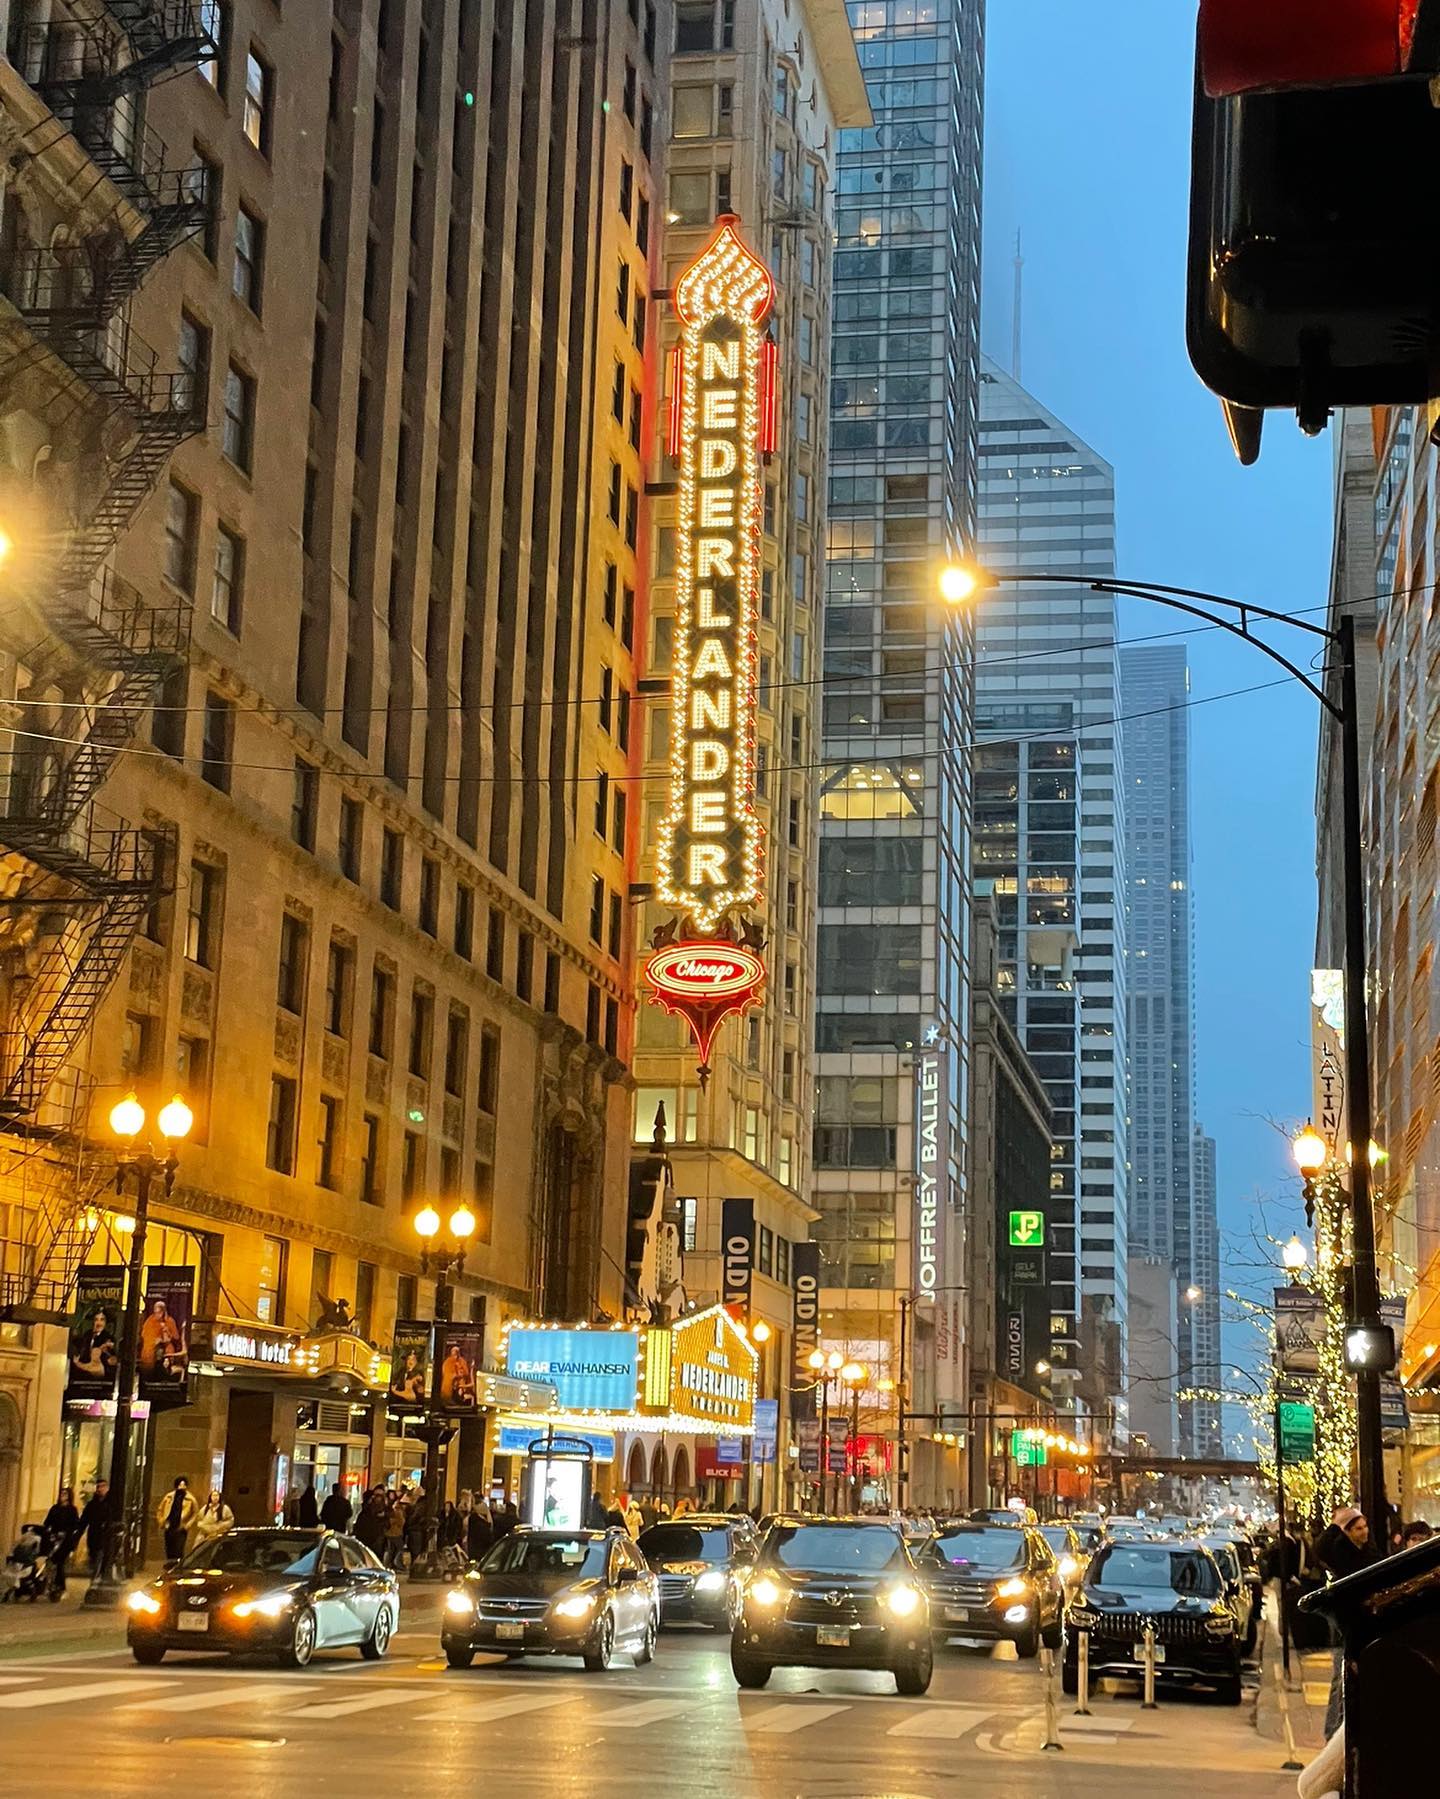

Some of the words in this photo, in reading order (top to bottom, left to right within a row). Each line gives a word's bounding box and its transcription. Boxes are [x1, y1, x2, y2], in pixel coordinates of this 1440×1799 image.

[687, 338, 740, 885] NEDERLANDER
[676, 960, 734, 983] Chicago
[922, 1057, 938, 1162] BALLET
[726, 1236, 750, 1287] OLD
[919, 1174, 936, 1303] JOFFREY
[796, 1275, 817, 1320] OLD
[216, 1333, 256, 1360] CAMBRIA
[261, 1340, 290, 1364] hotel
[515, 1360, 549, 1371] DEAR
[550, 1362, 580, 1374] EVAN
[581, 1363, 630, 1375] HANSEN
[794, 1324, 817, 1382] NAVY
[1009, 1318, 1021, 1370] ROSS
[682, 1362, 749, 1403] NEDERLANDER
[691, 1394, 739, 1418] THEATRE
